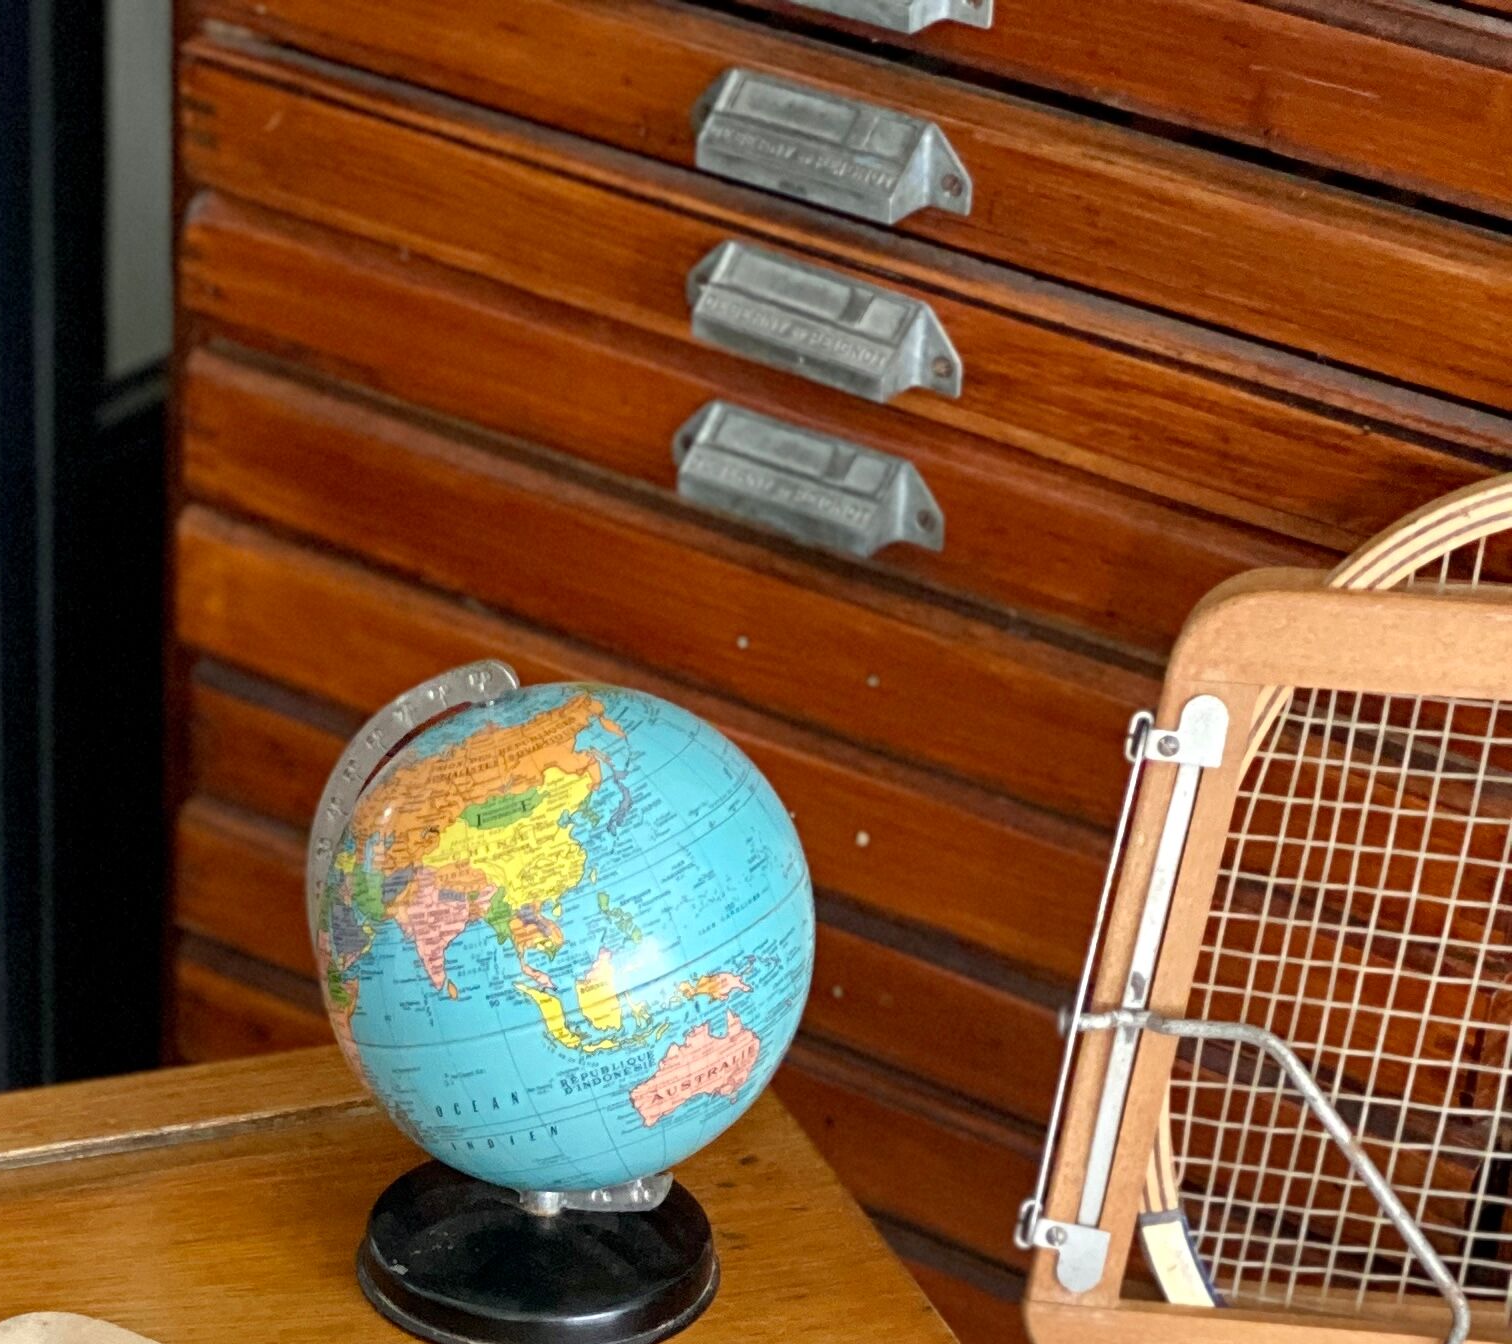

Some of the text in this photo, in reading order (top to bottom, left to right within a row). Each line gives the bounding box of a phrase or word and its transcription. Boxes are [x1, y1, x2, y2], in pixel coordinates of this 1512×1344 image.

[651, 1045, 756, 1104] AUSTRALIE
[435, 1091, 520, 1118] OCEAN
[451, 1125, 558, 1151] INDIEN
